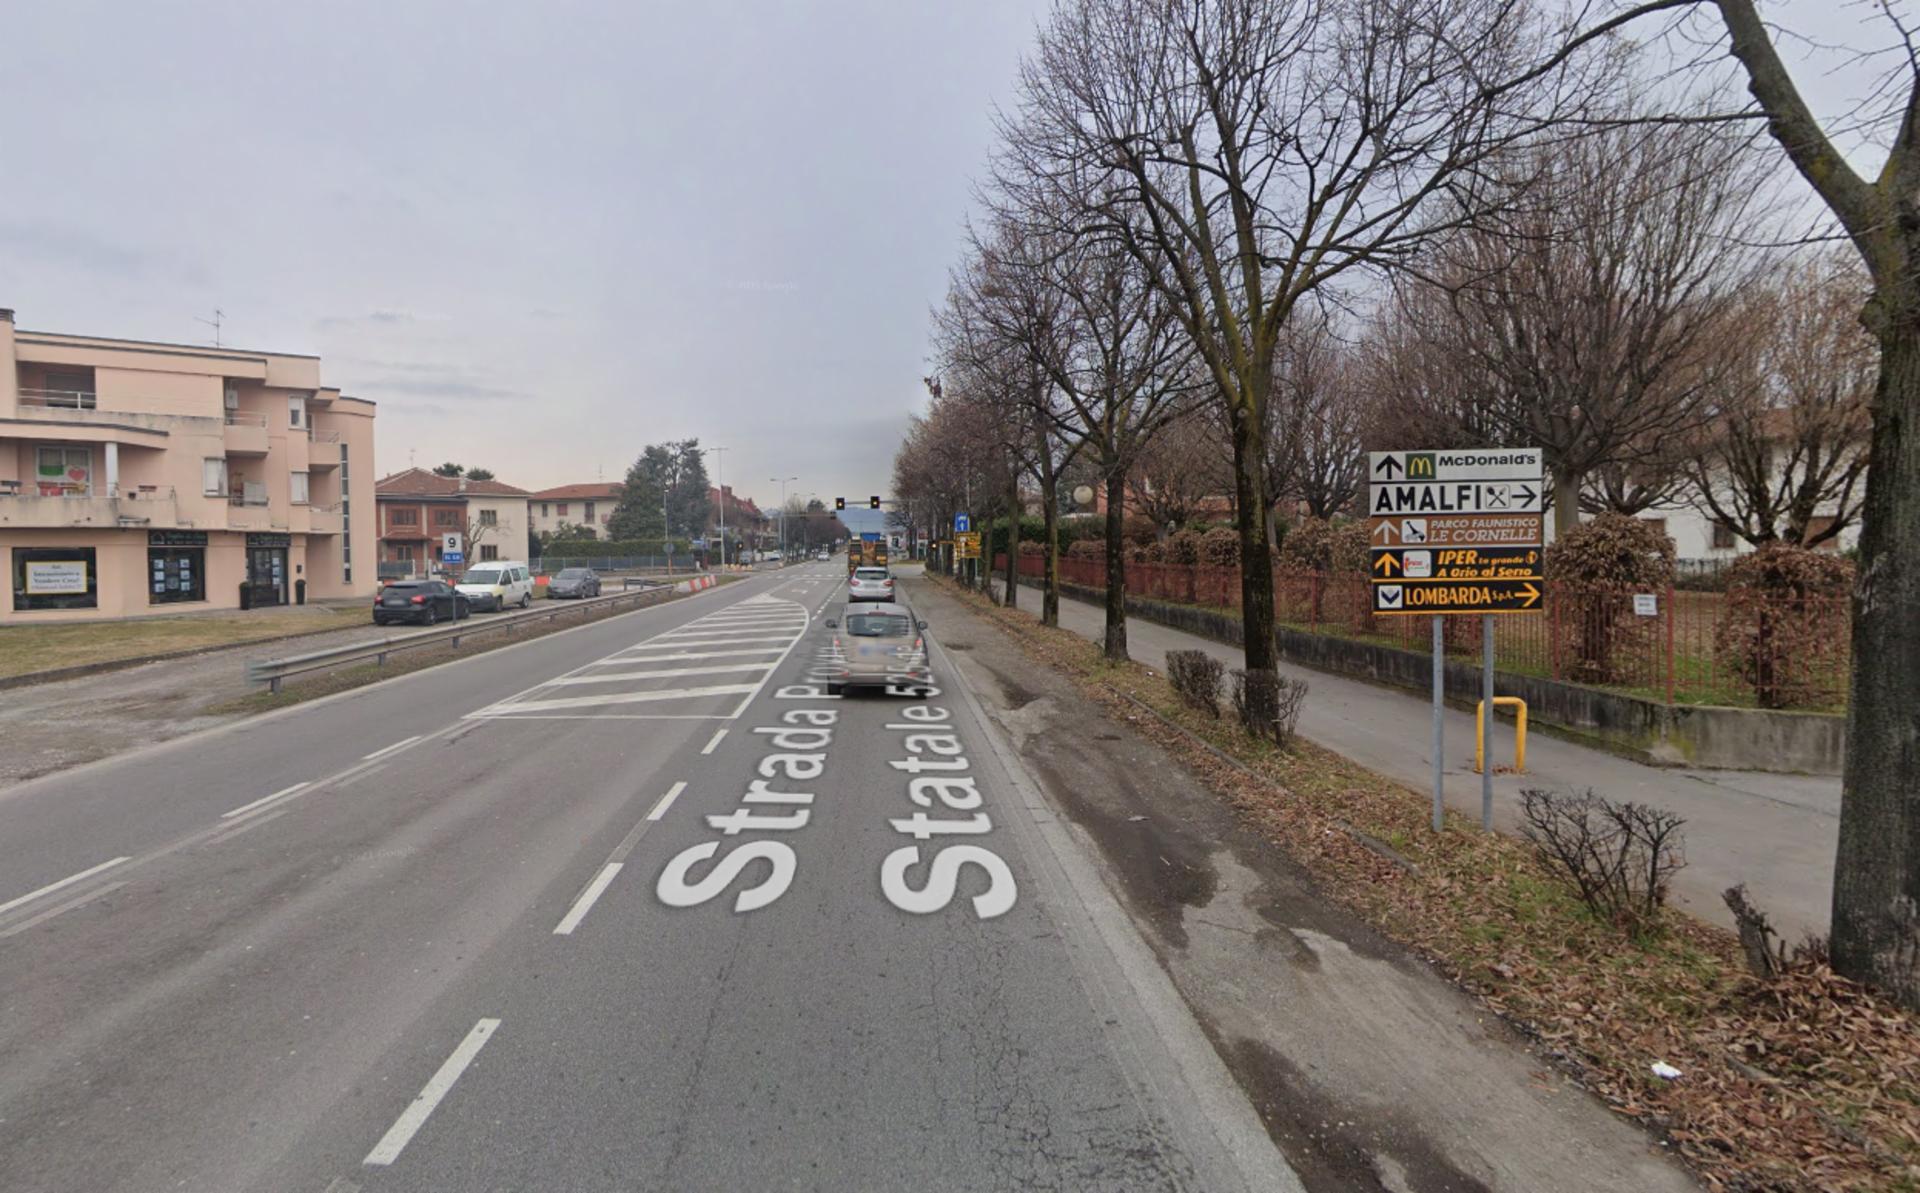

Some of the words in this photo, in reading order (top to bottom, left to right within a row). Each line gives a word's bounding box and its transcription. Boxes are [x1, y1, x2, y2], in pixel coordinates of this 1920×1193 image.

[1438, 454, 1536, 467] McDonald's
[1375, 484, 1481, 512] AMALFI
[1431, 519, 1469, 529] PARCO
[1471, 518, 1539, 528] FAUNISTICO
[1429, 530, 1449, 542] LE
[1452, 529, 1537, 542] CORNELLE
[448, 537, 456, 548] 9
[1437, 551, 1478, 565] IPER
[1490, 556, 1524, 565] grande
[1437, 568, 1447, 577] A
[1450, 567, 1478, 577] Orio
[1481, 566, 1494, 577] al
[1498, 567, 1533, 577] Serio
[1405, 587, 1492, 605] LOMBARDA
